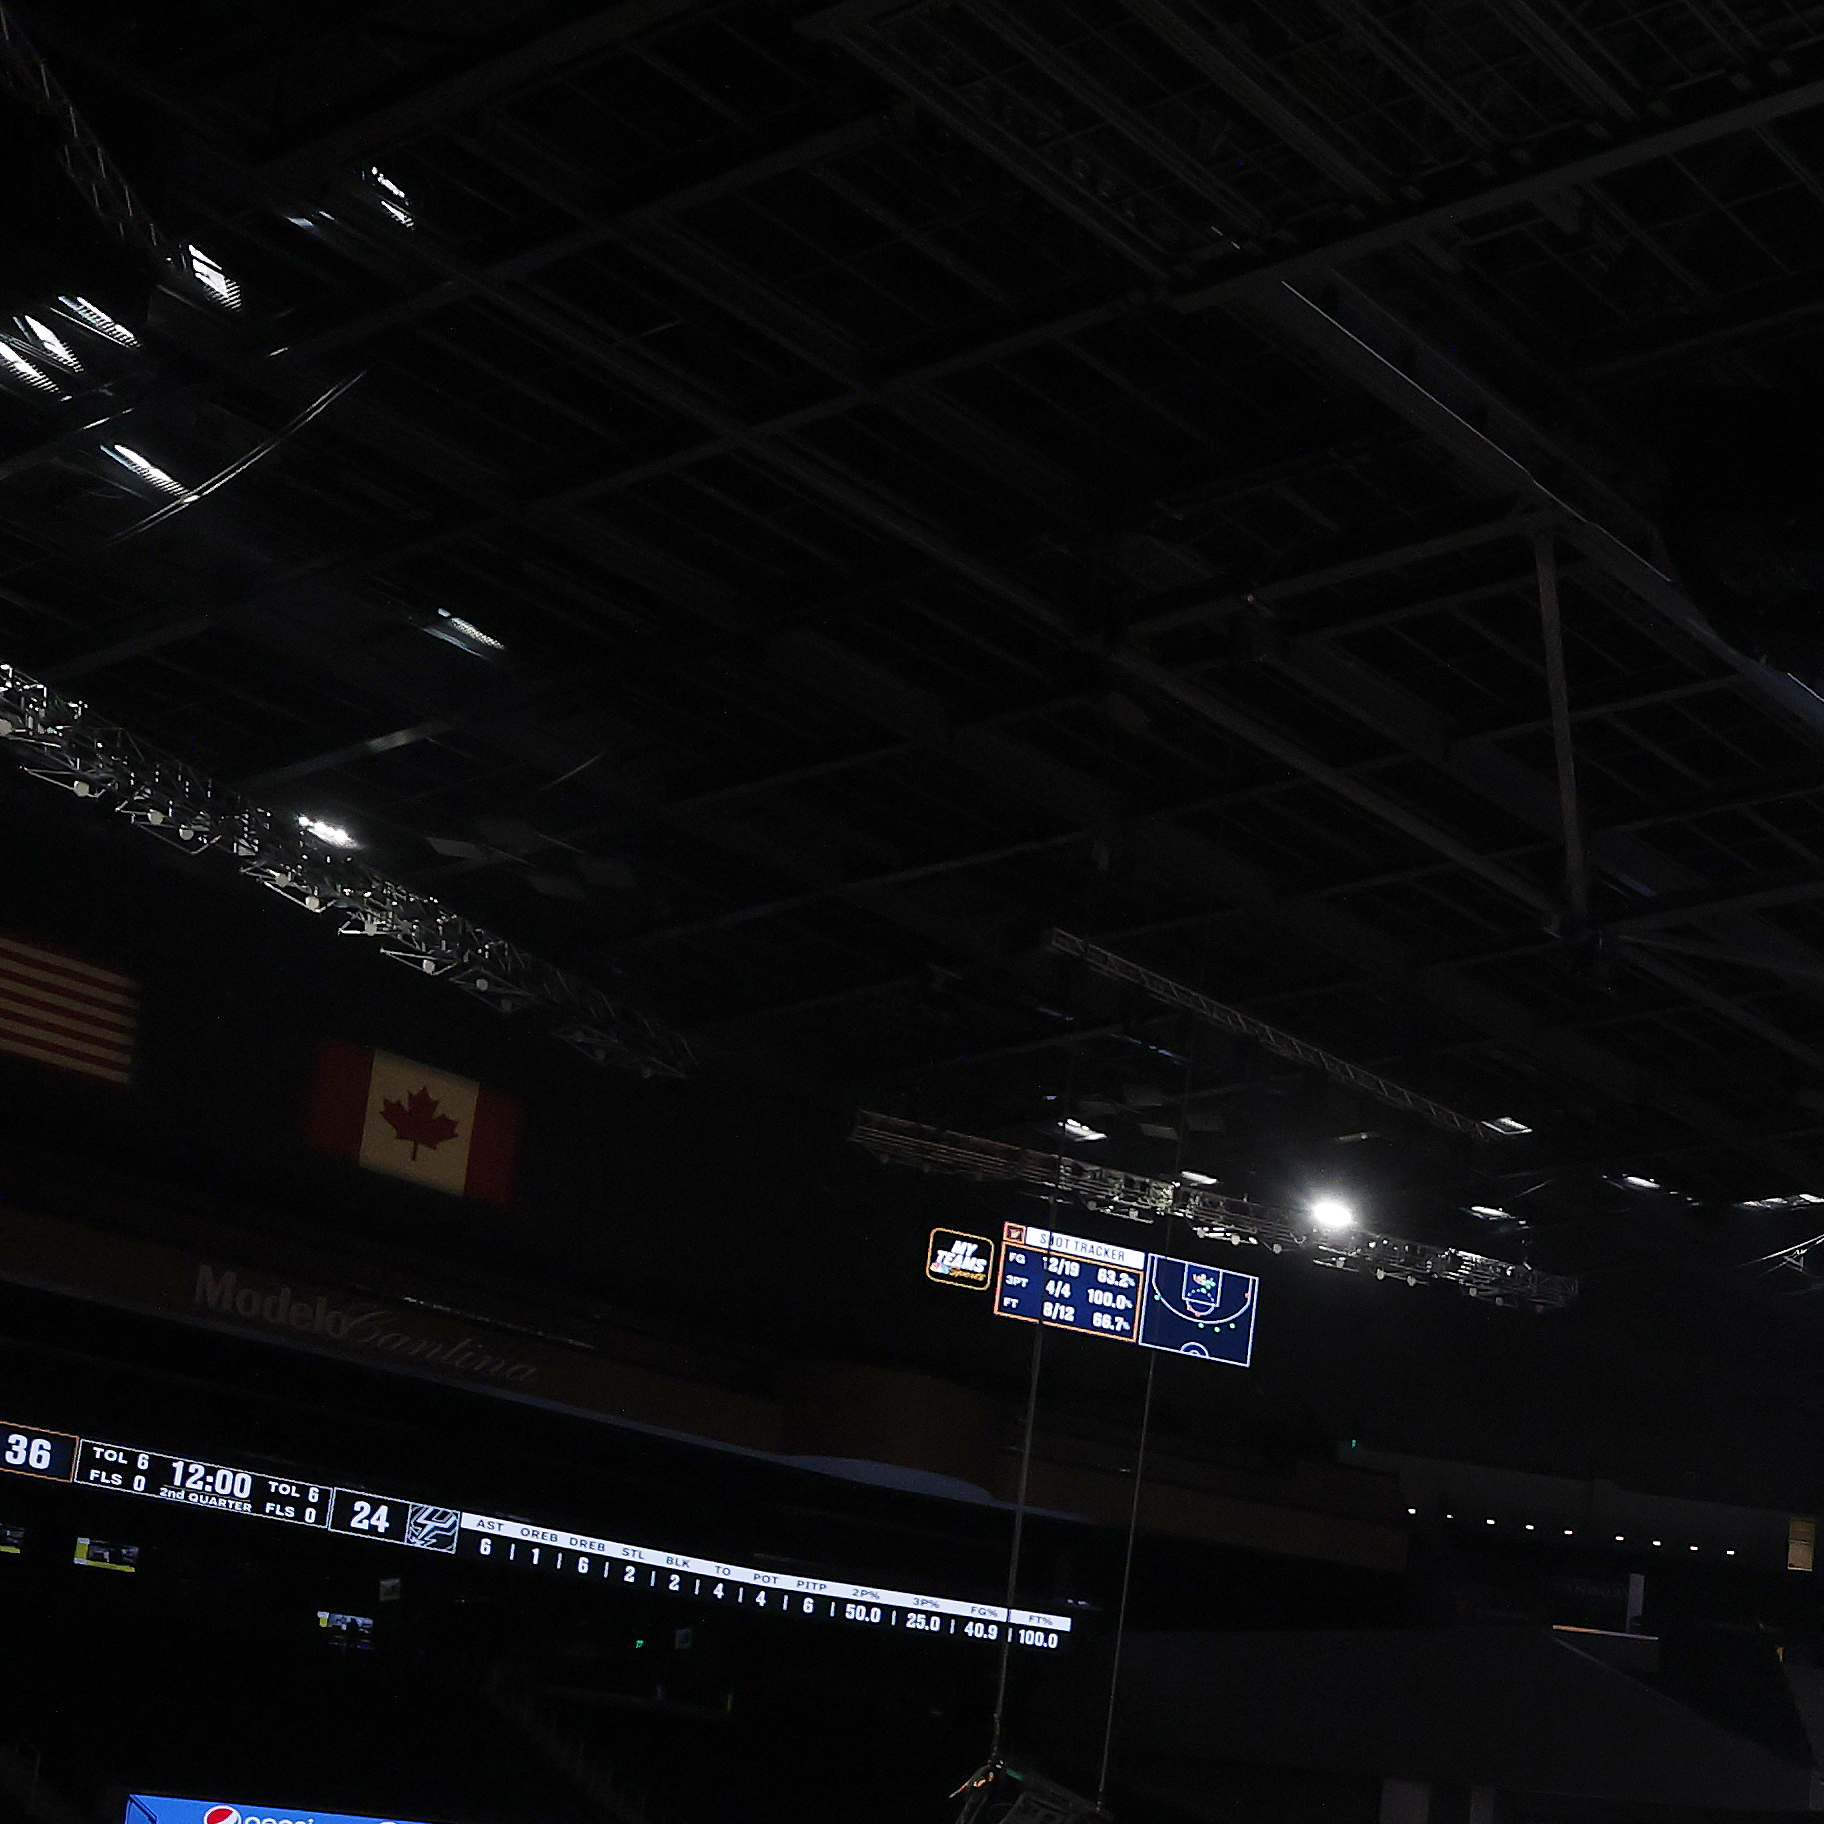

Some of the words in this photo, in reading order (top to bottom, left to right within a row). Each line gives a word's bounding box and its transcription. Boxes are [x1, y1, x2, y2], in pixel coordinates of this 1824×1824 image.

[936, 1250, 986, 1273] TEAMS
[952, 1240, 978, 1255] MY
[4, 1434, 51, 1469] 36
[171, 1461, 252, 1498] 12:00
[159, 1487, 185, 1500] 2nd
[189, 1492, 252, 1512] QUARTER
[350, 1501, 389, 1533] 24
